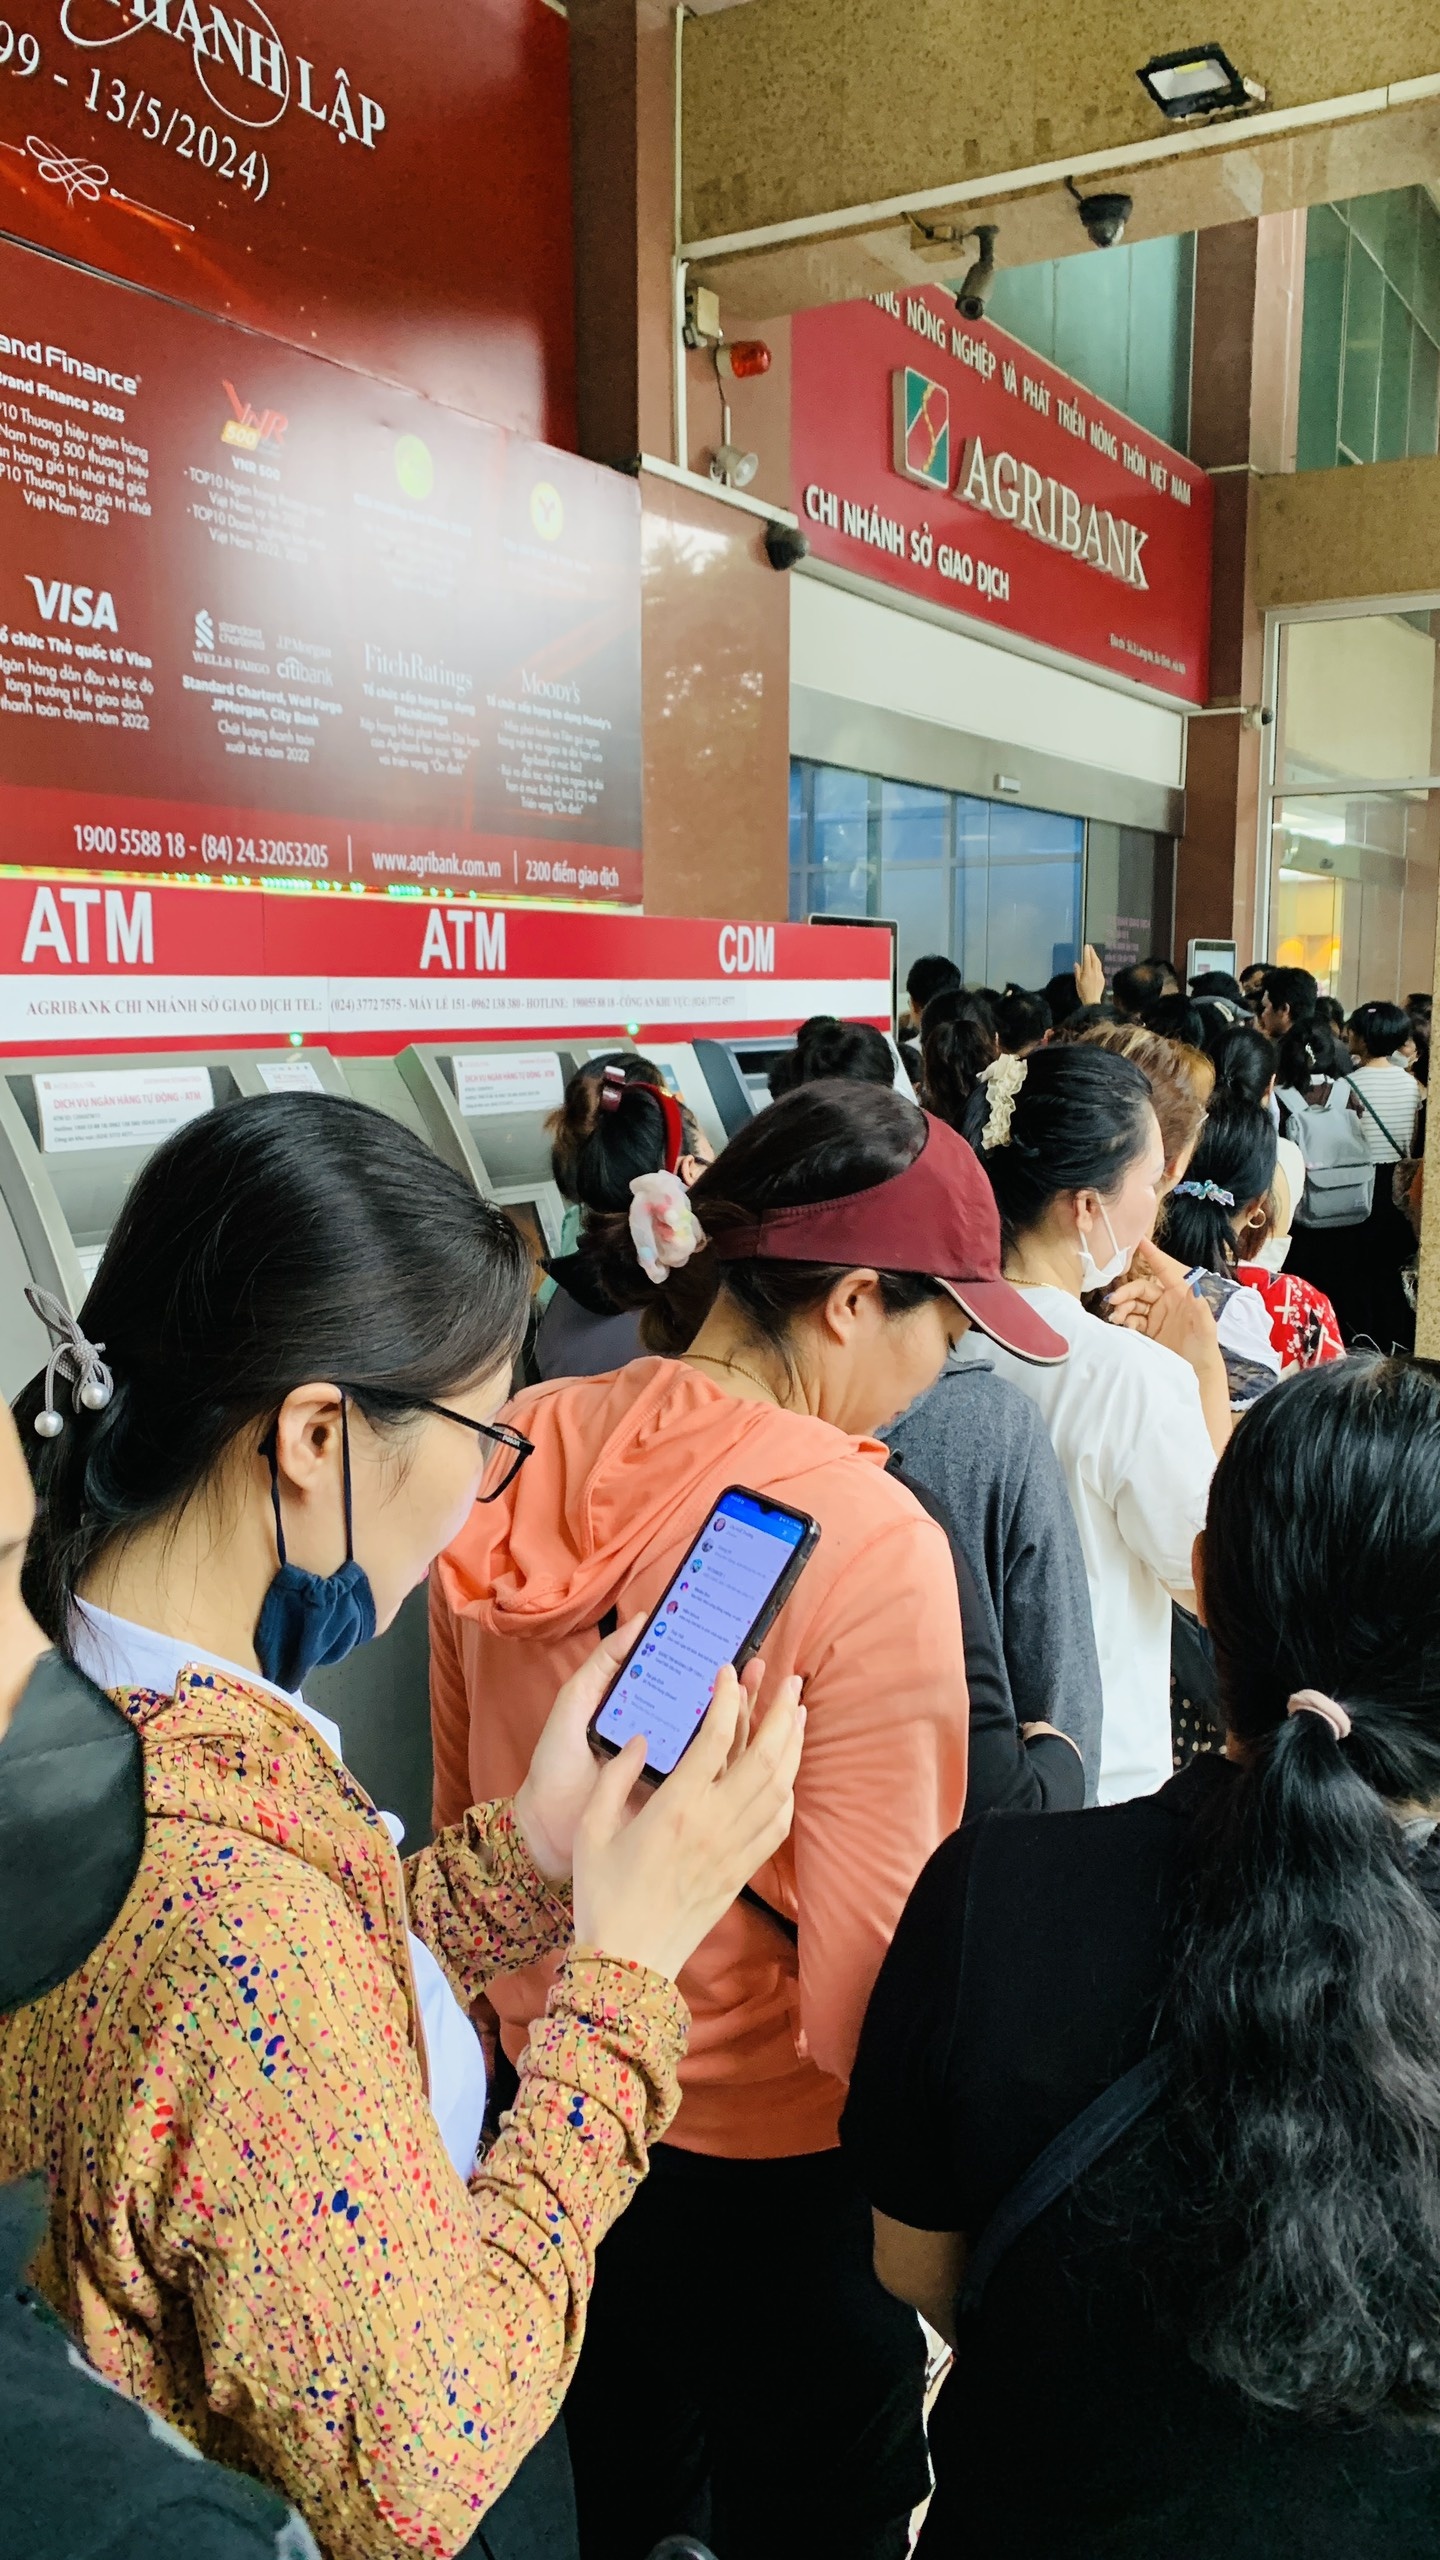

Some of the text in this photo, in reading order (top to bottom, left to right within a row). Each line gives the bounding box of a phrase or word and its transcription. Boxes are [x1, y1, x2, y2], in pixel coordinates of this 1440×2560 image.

[296, 56, 386, 149] LẬP
[85, 68, 269, 201] 13/5/2024)
[46, 346, 137, 396] Finance
[0, 370, 125, 423] rand Finance 2023
[907, 296, 1191, 507] NÔNG NGHIỆP VÀ PHÁT TRIỂN NÔNG THÔN VIỆT NAM
[0, 401, 18, 421] 10
[65, 419, 89, 442] hiệu
[92, 432, 119, 452] ngân
[121, 436, 148, 463] hàng
[13, 443, 43, 473] hàng
[45, 458, 64, 476] giá
[67, 463, 79, 481] trị
[30, 433, 60, 457] trong
[62, 440, 85, 460] 500
[126, 457, 149, 479] hiệu
[22, 488, 109, 525] Việt Nam 2023
[68, 479, 92, 502] hiệu
[94, 491, 113, 508] giá
[115, 495, 127, 513] trị
[963, 435, 1150, 590] AGRIBANK
[806, 484, 1009, 602] CHI NHÁNH SỞ GIAO DỊCH
[24, 574, 119, 633] VISA
[11, 631, 45, 650] chức
[46, 636, 73, 655] Thẻ
[75, 643, 108, 660] quốc
[109, 646, 124, 664] tế
[125, 650, 152, 669] Visa
[192, 650, 232, 668] WELLS
[27, 657, 57, 682] hàng
[182, 674, 234, 696] Standard
[276, 656, 334, 687] citibank
[0, 693, 33, 714] thanh
[35, 702, 61, 718] toán
[95, 712, 119, 727] năm
[120, 711, 150, 731] 2022
[94, 691, 119, 709] giao
[121, 692, 144, 711] dịch
[270, 707, 291, 725] City
[294, 711, 320, 727] Bank
[286, 746, 310, 763] 2022
[73, 824, 117, 854] 1900
[120, 828, 161, 858] 5588
[165, 832, 186, 858] 18
[201, 833, 233, 865] (84)
[236, 837, 329, 868] 24.32053205
[372, 851, 501, 879] www.agribank.com.vn
[525, 859, 620, 891] 2300 điểm giao dịch
[21, 886, 155, 964] ATM
[419, 908, 507, 972] ATM
[718, 925, 775, 974] CDM
[27, 1000, 110, 1015] AGRIBANK
[115, 999, 141, 1014] CHI
[146, 994, 197, 1013] NHÁNH
[201, 994, 218, 1012] SỞ
[222, 998, 257, 1012] GIAO
[261, 998, 292, 1014] DỊCH
[295, 998, 322, 1012] TEL:
[330, 998, 355, 1014] (024)
[53, 1098, 75, 1110] DỊCH
[76, 1097, 89, 1110] VỤ
